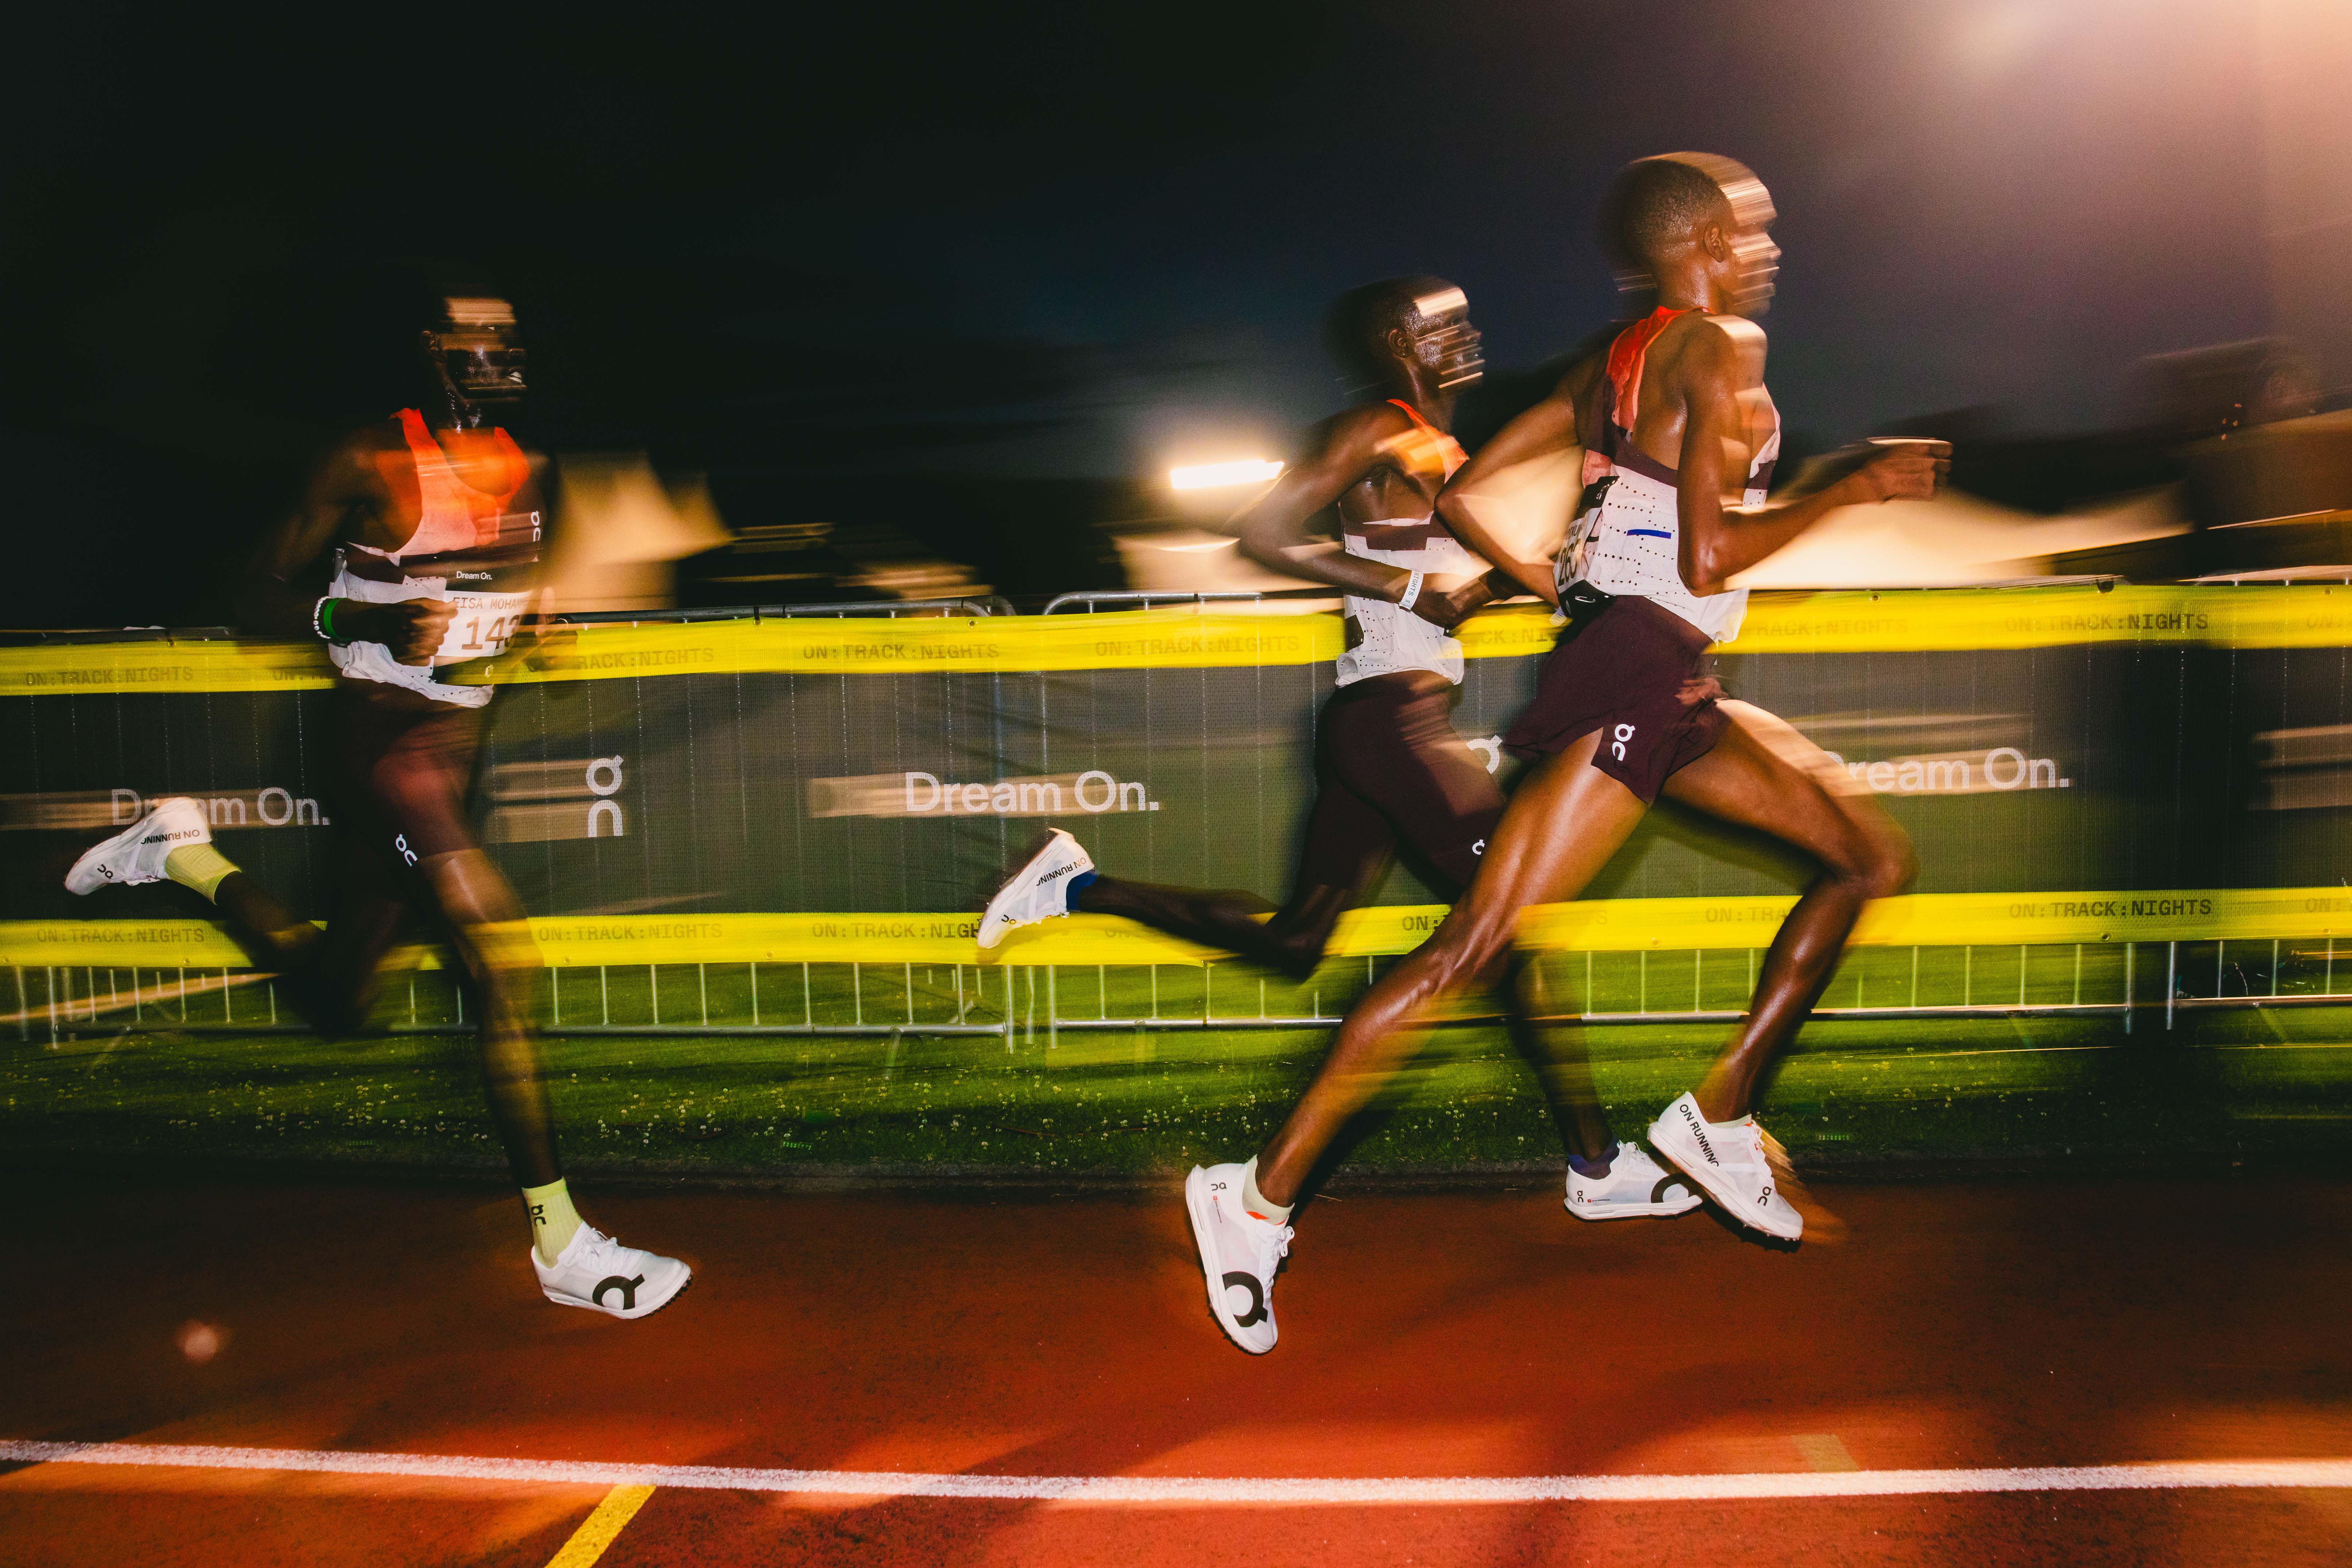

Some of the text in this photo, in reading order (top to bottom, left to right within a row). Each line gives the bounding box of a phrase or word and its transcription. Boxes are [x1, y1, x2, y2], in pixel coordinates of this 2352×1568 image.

[456, 571, 479, 579] Dream
[2004, 613, 2209, 633] ON:TRACK:NIGHTS
[802, 643, 1000, 660] ON:TRACK:NIGHTS
[1095, 635, 1300, 657] ON:TRACK:NIGHTS
[26, 666, 194, 687] ON:TRACK:NIGHTS
[1824, 747, 2069, 791] ream On.
[906, 770, 1159, 812] Dream On.
[258, 787, 330, 825] On.
[184, 829, 200, 838] ON
[1073, 857, 1086, 869] ON
[2009, 898, 2212, 918] ON:TRACK:NIGHTS
[37, 928, 205, 943] ON:TRACK:NIGHTS
[538, 923, 722, 941] ON:TRACK:NIGHTS
[1679, 1104, 1695, 1121] ON
